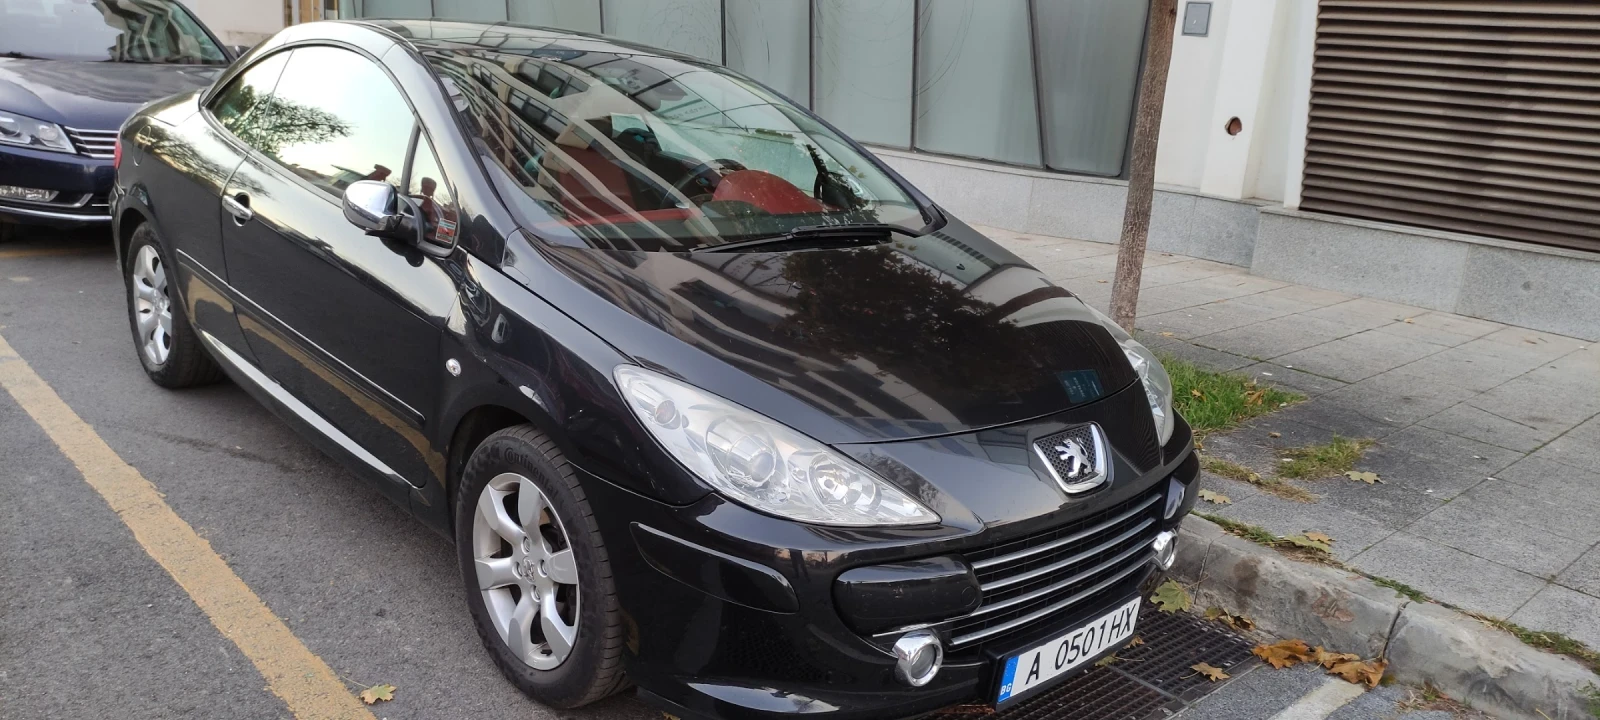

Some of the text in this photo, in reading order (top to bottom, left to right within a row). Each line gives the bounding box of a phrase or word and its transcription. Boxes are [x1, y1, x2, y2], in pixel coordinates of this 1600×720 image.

[504, 447, 559, 500] Continental
[1025, 651, 1041, 686] A
[1000, 682, 1012, 695] BG
